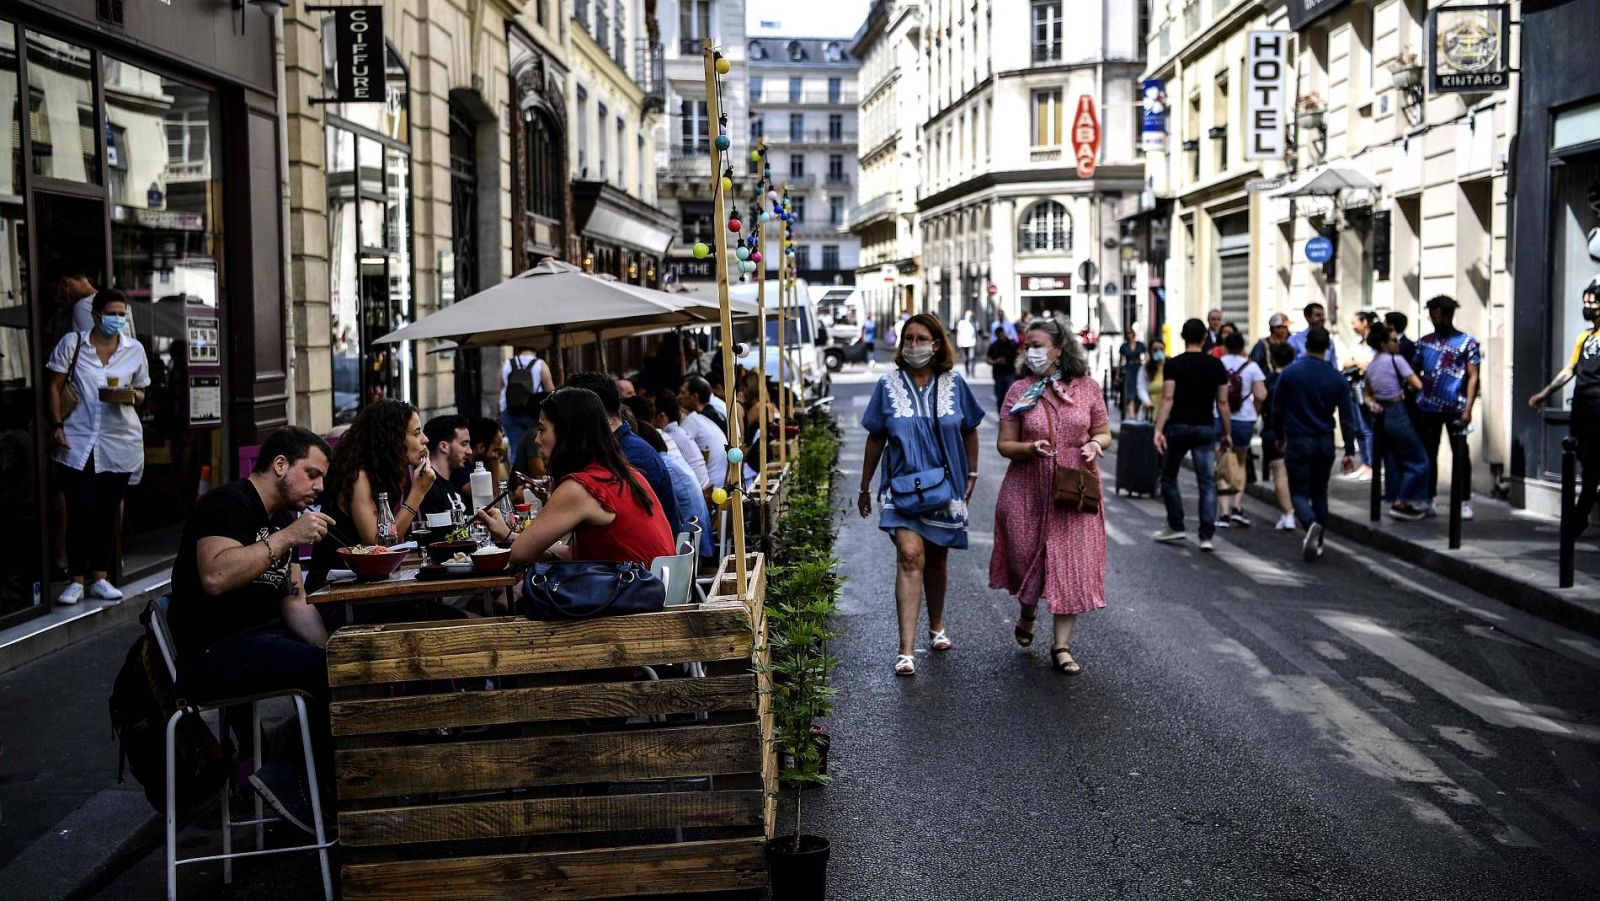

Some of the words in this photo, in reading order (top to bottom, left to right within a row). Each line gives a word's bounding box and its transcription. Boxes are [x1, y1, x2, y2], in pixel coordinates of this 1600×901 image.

[350, 10, 369, 98] COIFFURE
[1253, 36, 1281, 153] HOTEL
[1441, 73, 1503, 87] KINTARO
[1076, 95, 1096, 177] TABAC
